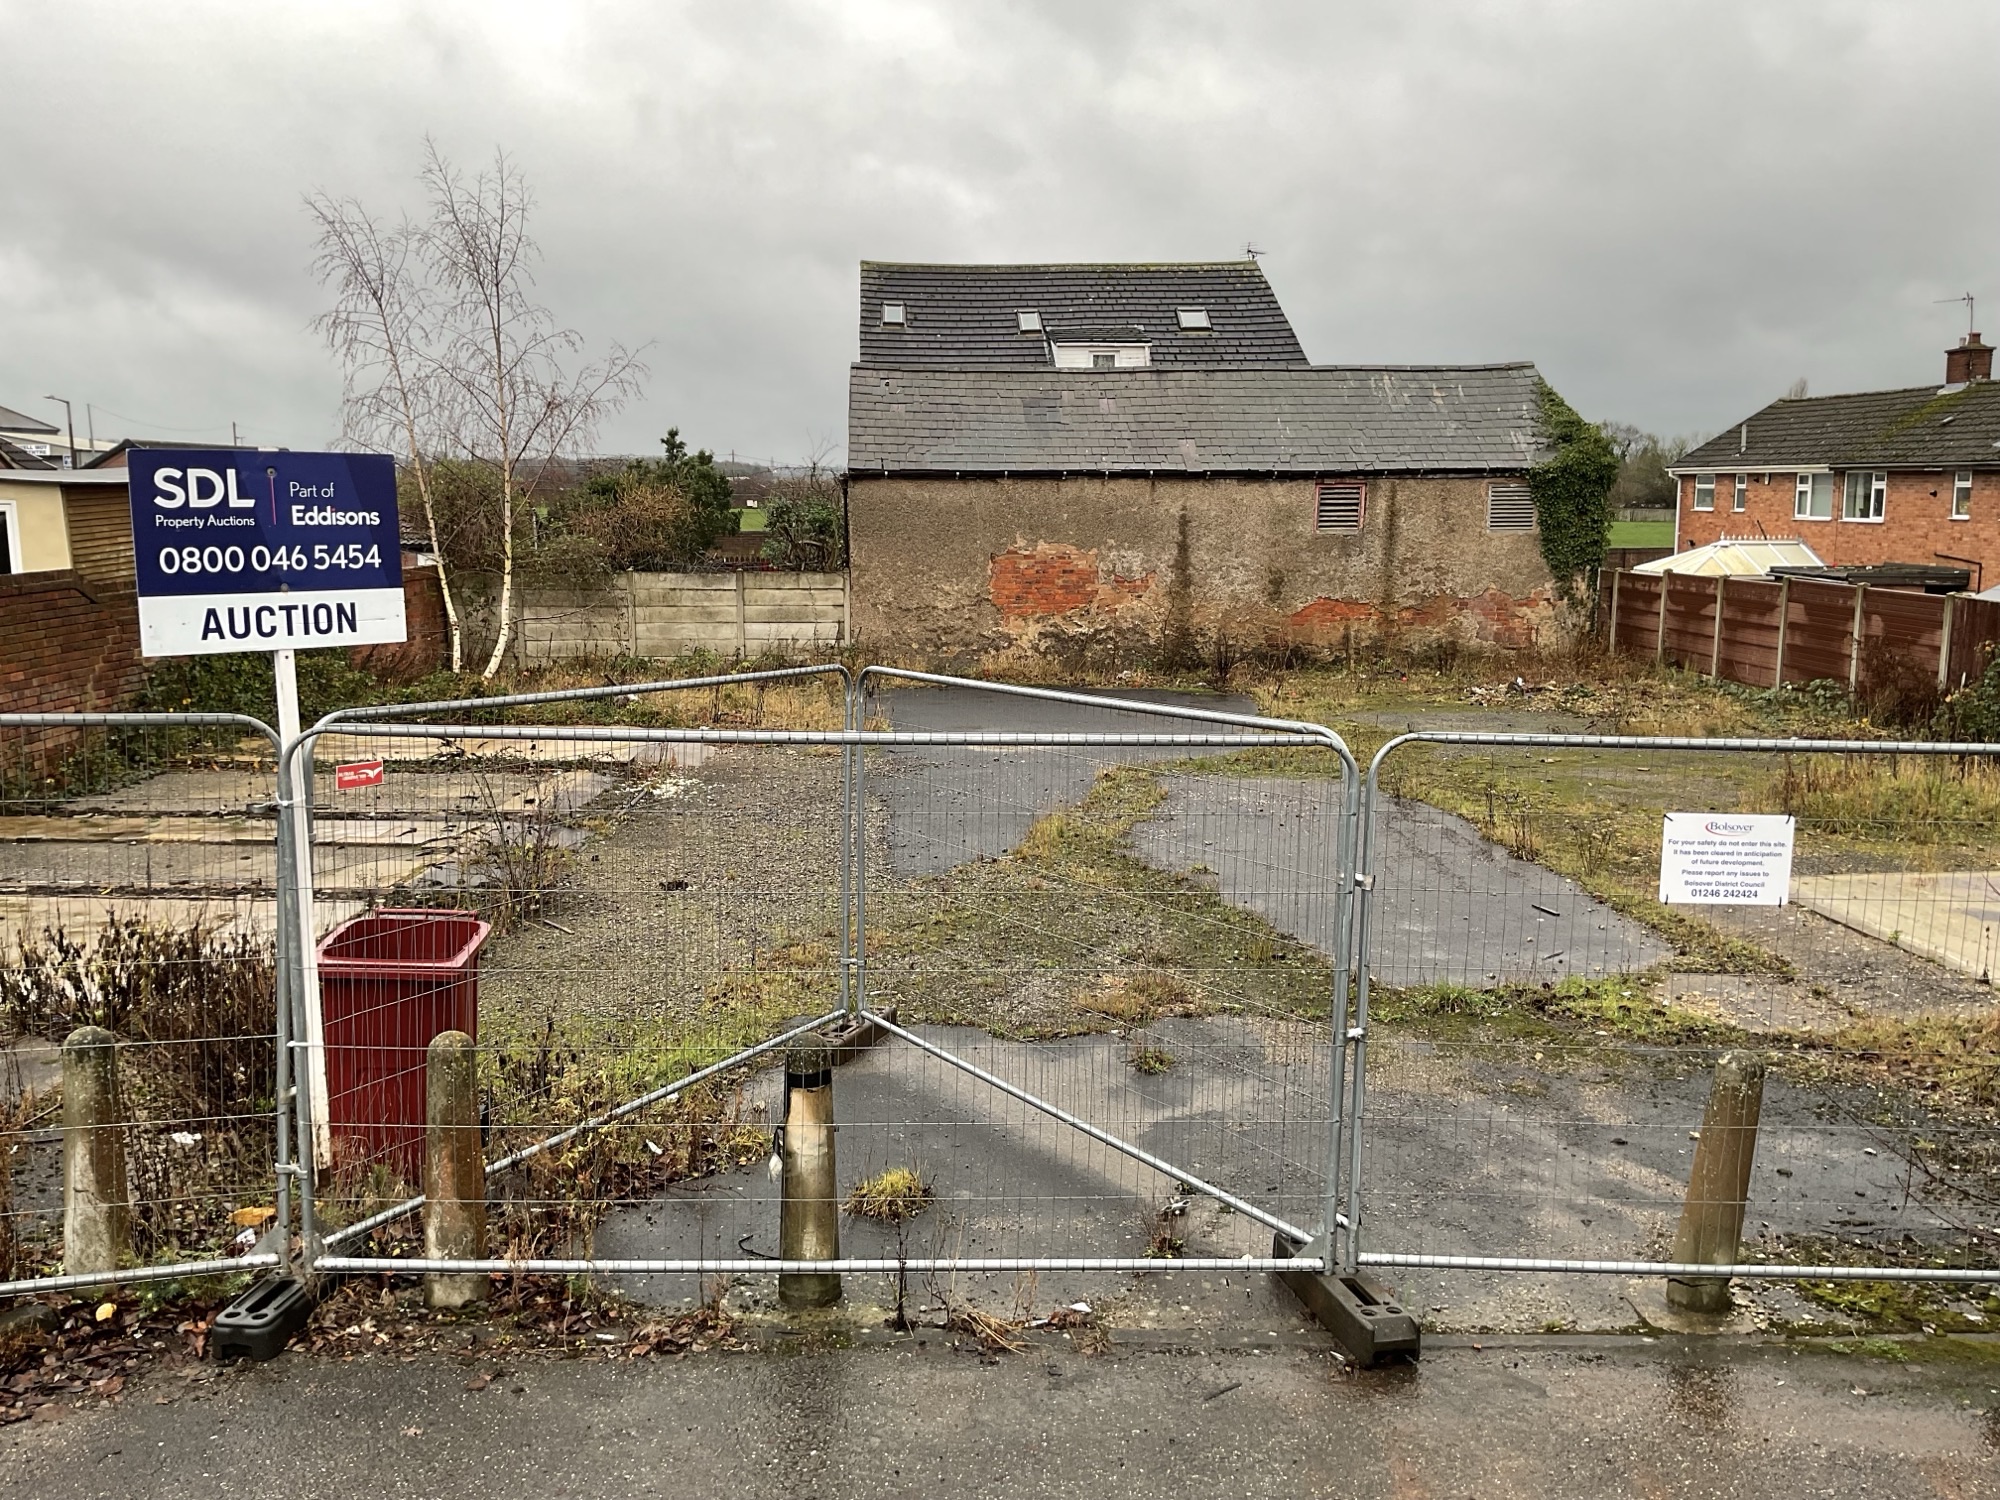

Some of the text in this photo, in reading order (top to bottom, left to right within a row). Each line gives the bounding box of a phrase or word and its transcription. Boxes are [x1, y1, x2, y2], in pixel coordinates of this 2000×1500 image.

[154, 468, 256, 509] SDL
[290, 482, 334, 498] Part of
[155, 515, 256, 529] Property Auctions
[291, 504, 380, 526] Eddisons
[159, 544, 382, 574] 0800 046 5454
[200, 602, 358, 641] AUCTION
[1710, 822, 1754, 831] Bolsover
[1691, 888, 1758, 898] 01246 242424
